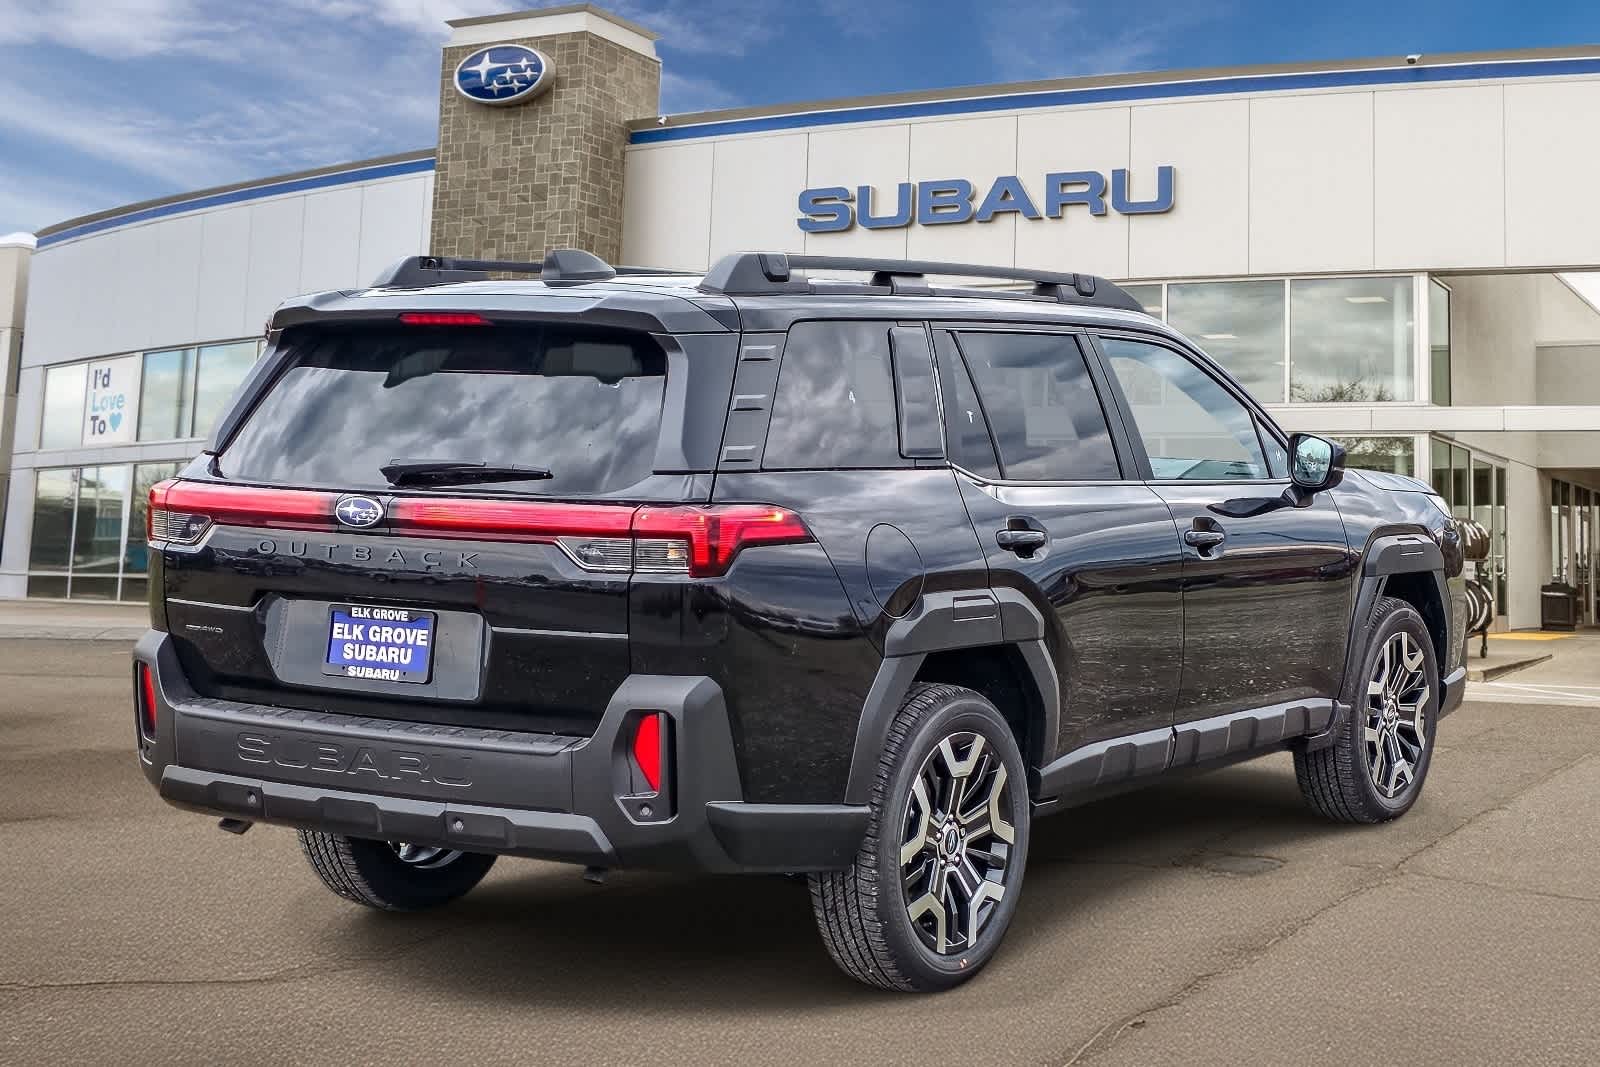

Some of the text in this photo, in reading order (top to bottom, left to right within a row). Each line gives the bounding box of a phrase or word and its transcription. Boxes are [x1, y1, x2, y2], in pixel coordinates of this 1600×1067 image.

[797, 165, 1176, 233] SUBARU
[94, 367, 111, 389] I'd
[91, 391, 126, 412] Love
[90, 415, 106, 435] To
[257, 538, 479, 569] OUTBACK
[351, 606, 409, 621] ELK GROVE
[332, 622, 429, 646] ELK GROVE
[342, 642, 413, 665] SUBARU
[347, 665, 400, 681] SUBARU
[237, 731, 473, 787] SUBARU
